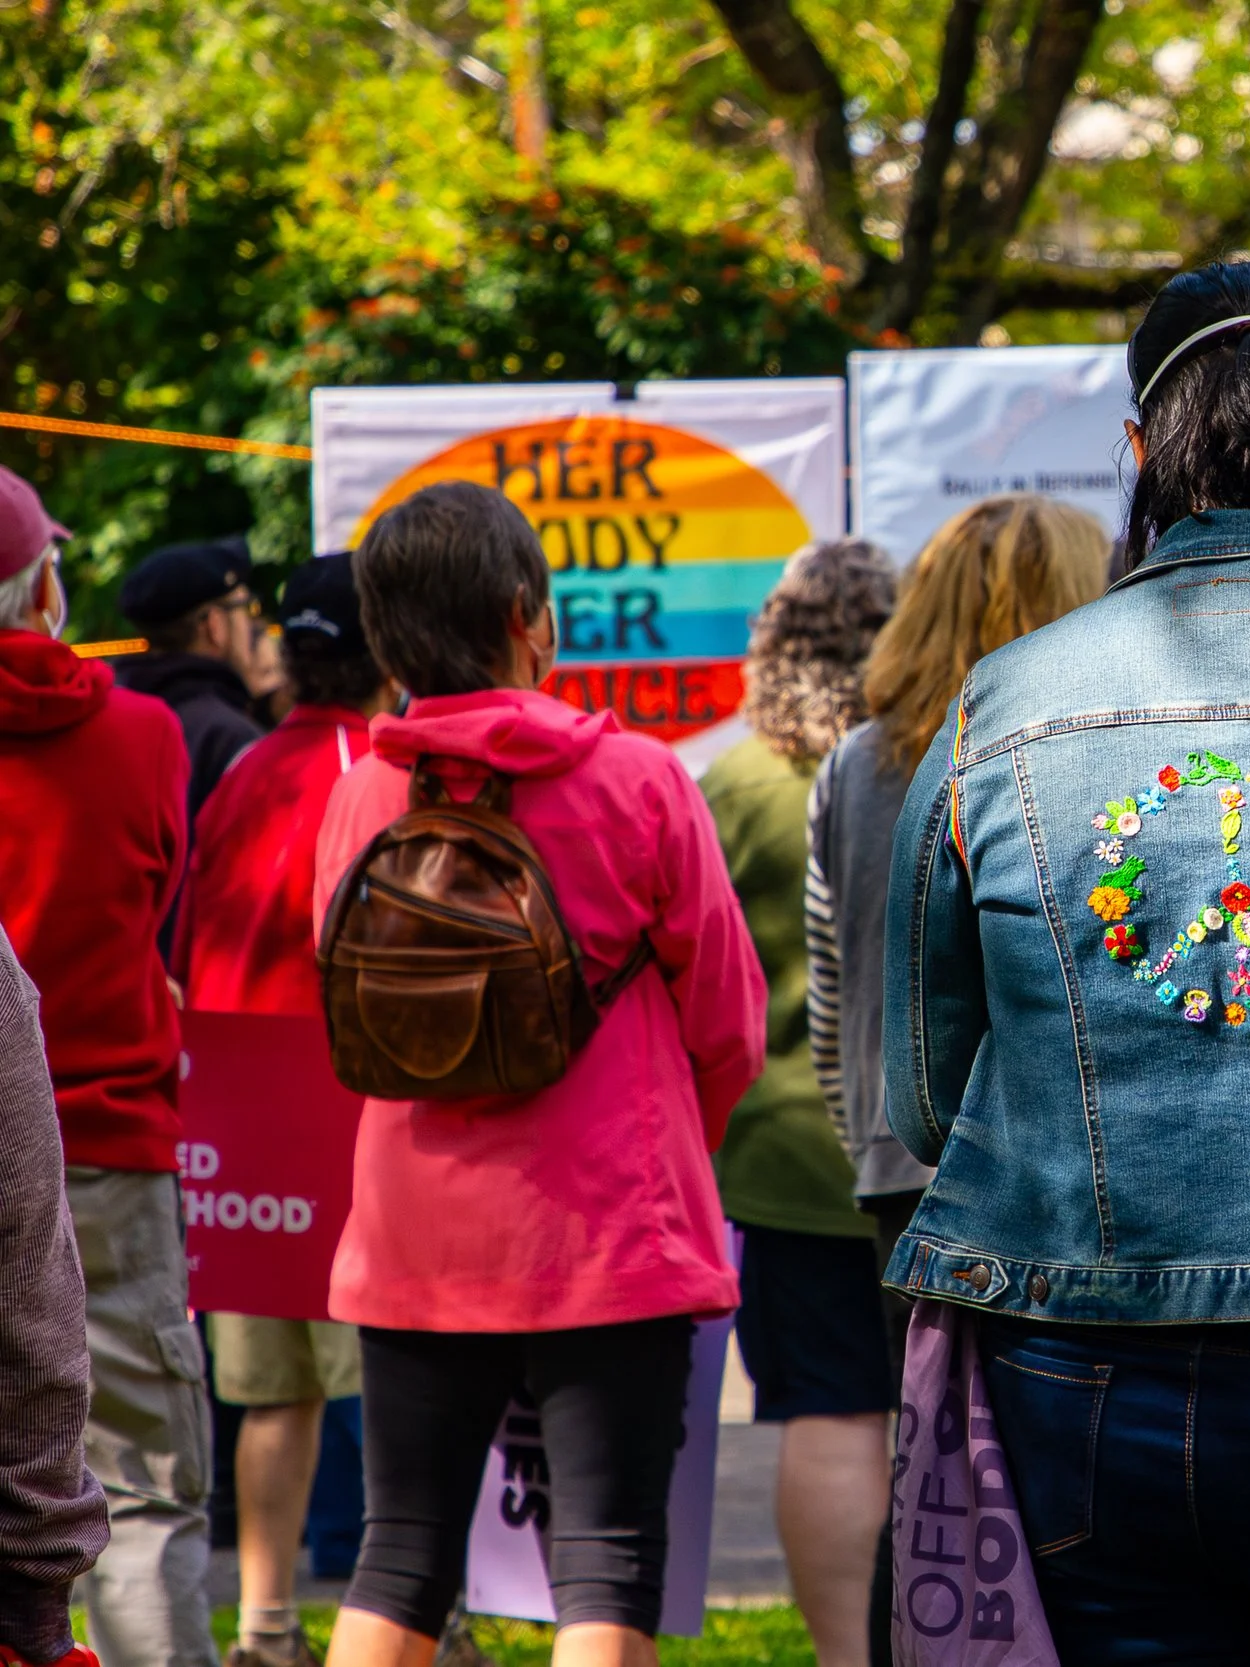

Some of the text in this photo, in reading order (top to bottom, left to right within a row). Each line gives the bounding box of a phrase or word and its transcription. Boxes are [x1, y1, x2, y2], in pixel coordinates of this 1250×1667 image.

[490, 437, 664, 501] HER
[538, 512, 681, 574] ODY
[559, 588, 670, 653] ER
[501, 1396, 550, 1532] IES
[907, 1471, 968, 1638] OFF
